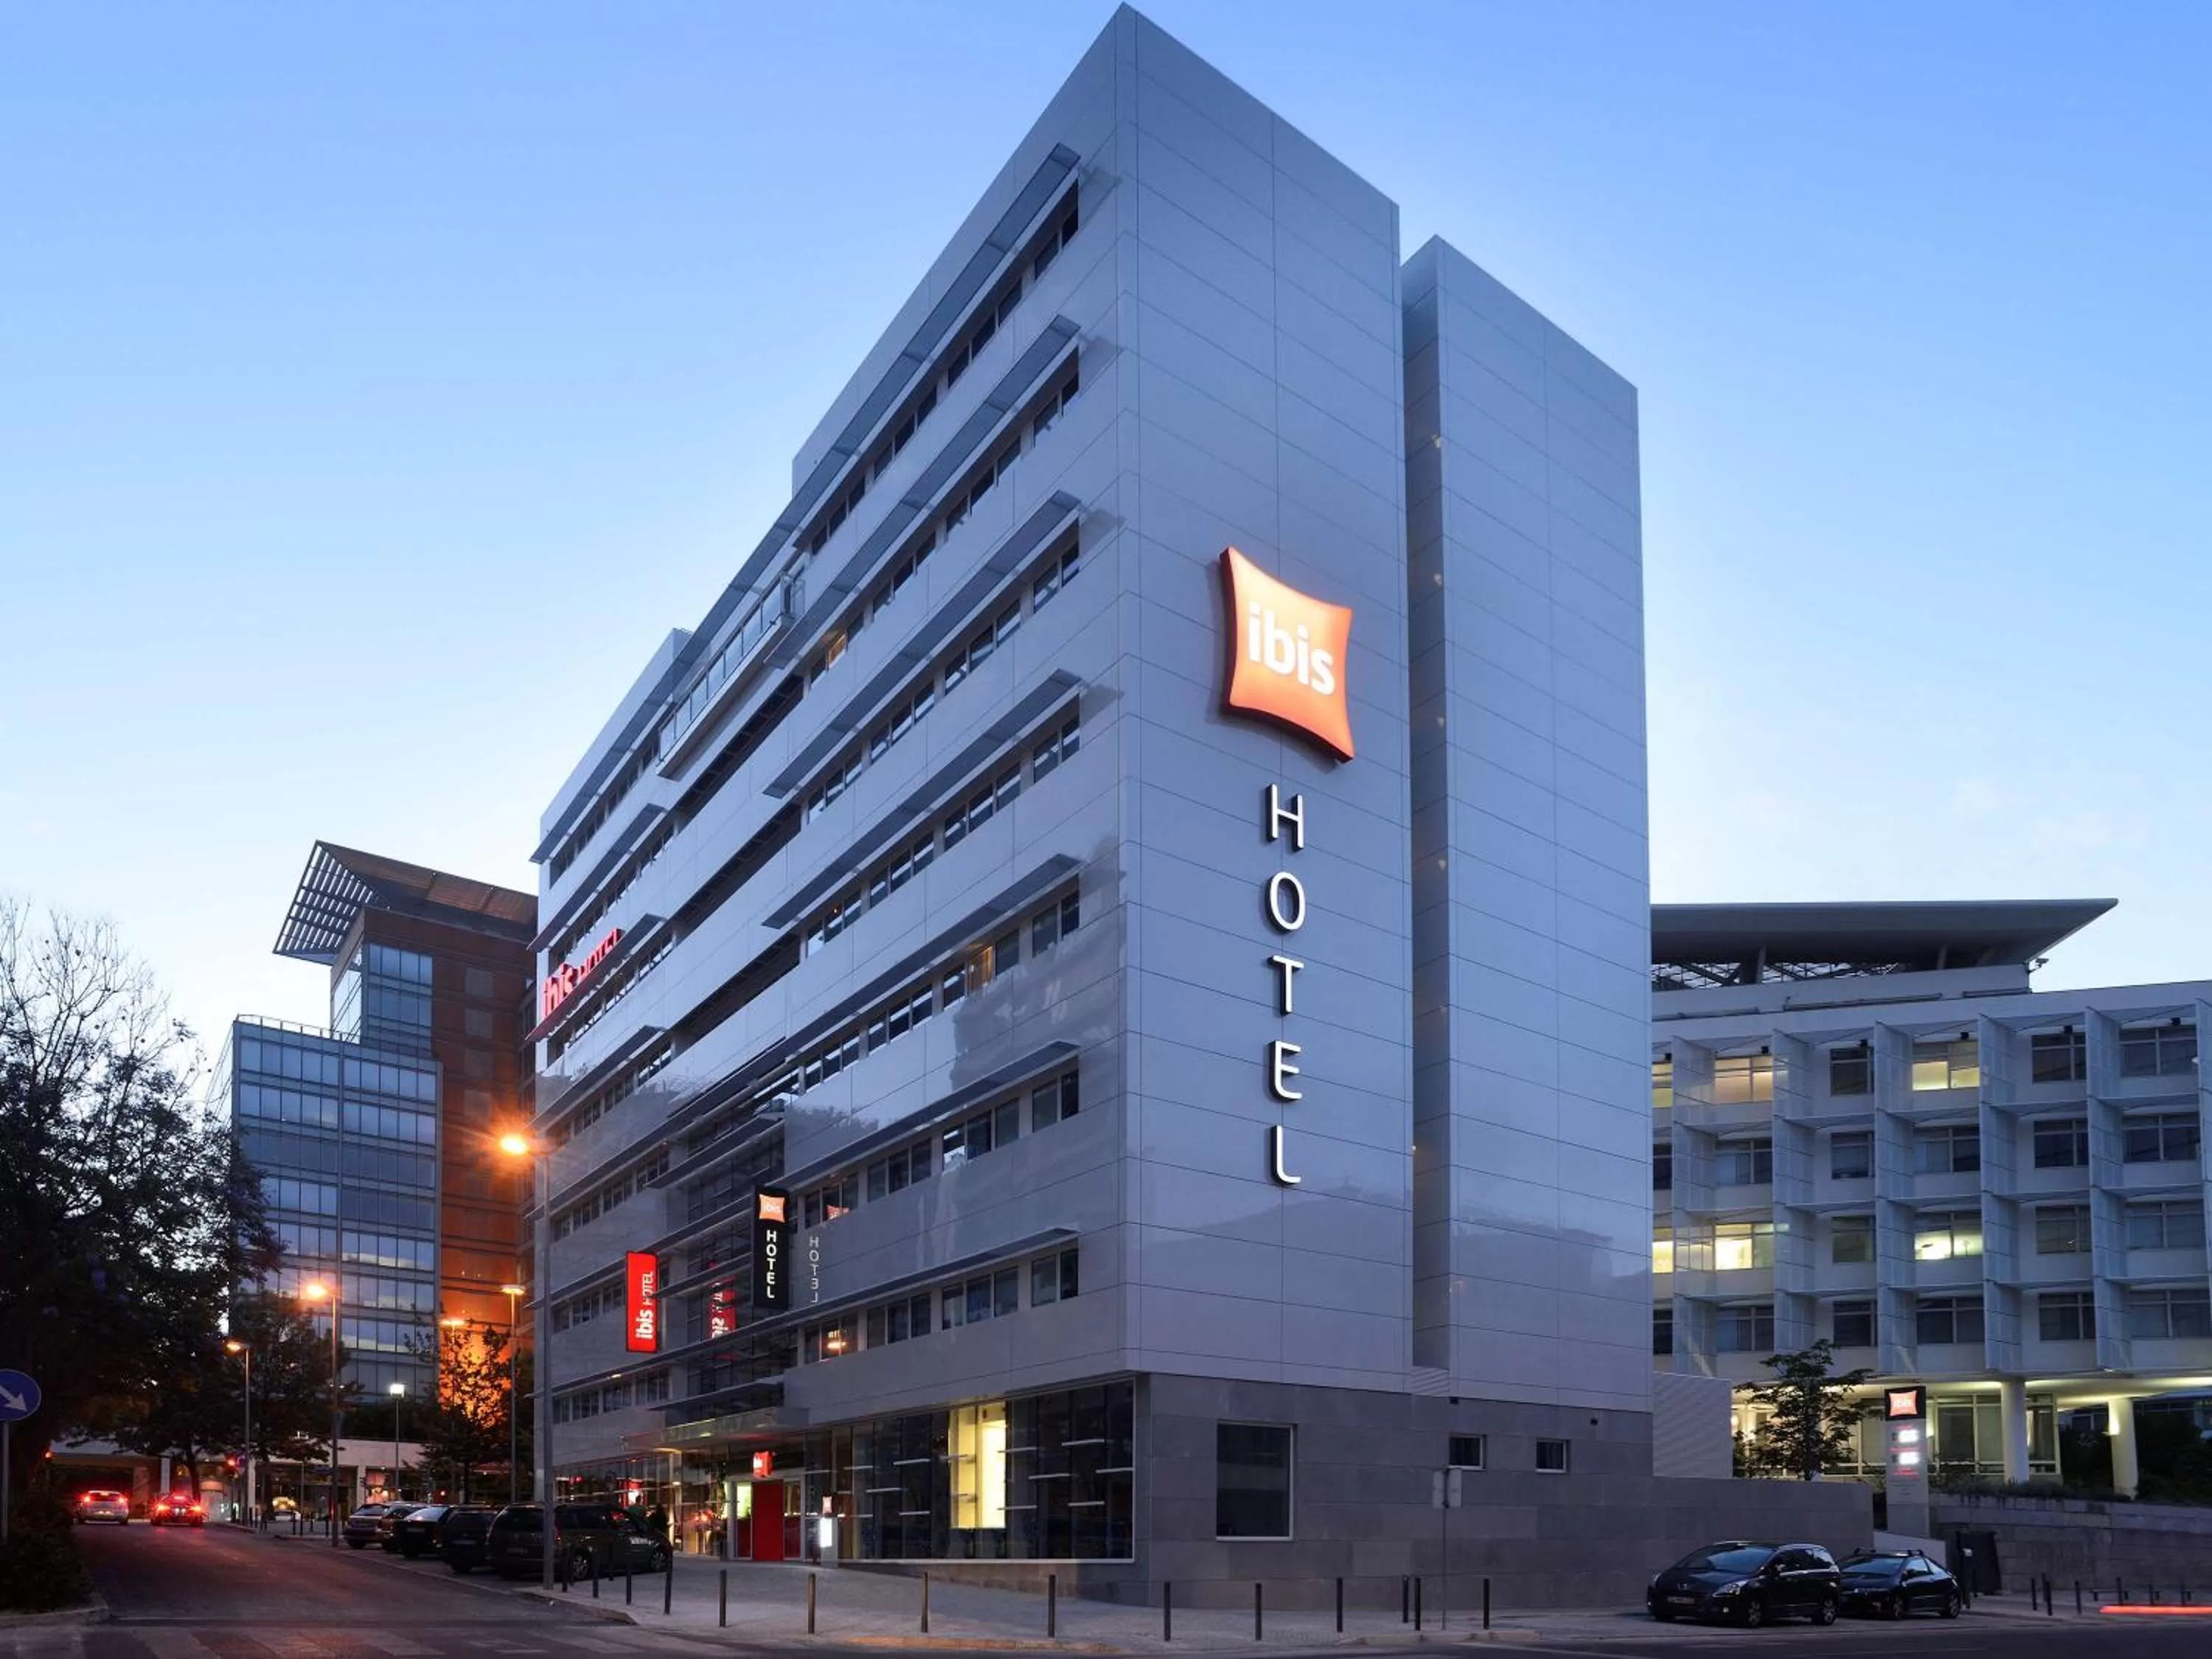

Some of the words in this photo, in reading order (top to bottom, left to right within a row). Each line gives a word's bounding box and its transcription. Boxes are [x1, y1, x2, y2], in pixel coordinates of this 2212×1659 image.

[1248, 601, 1335, 696] ibis
[1267, 783, 1306, 1185] HOTEL
[766, 1229, 777, 1298] HOTEL
[635, 1309, 655, 1340] ibis
